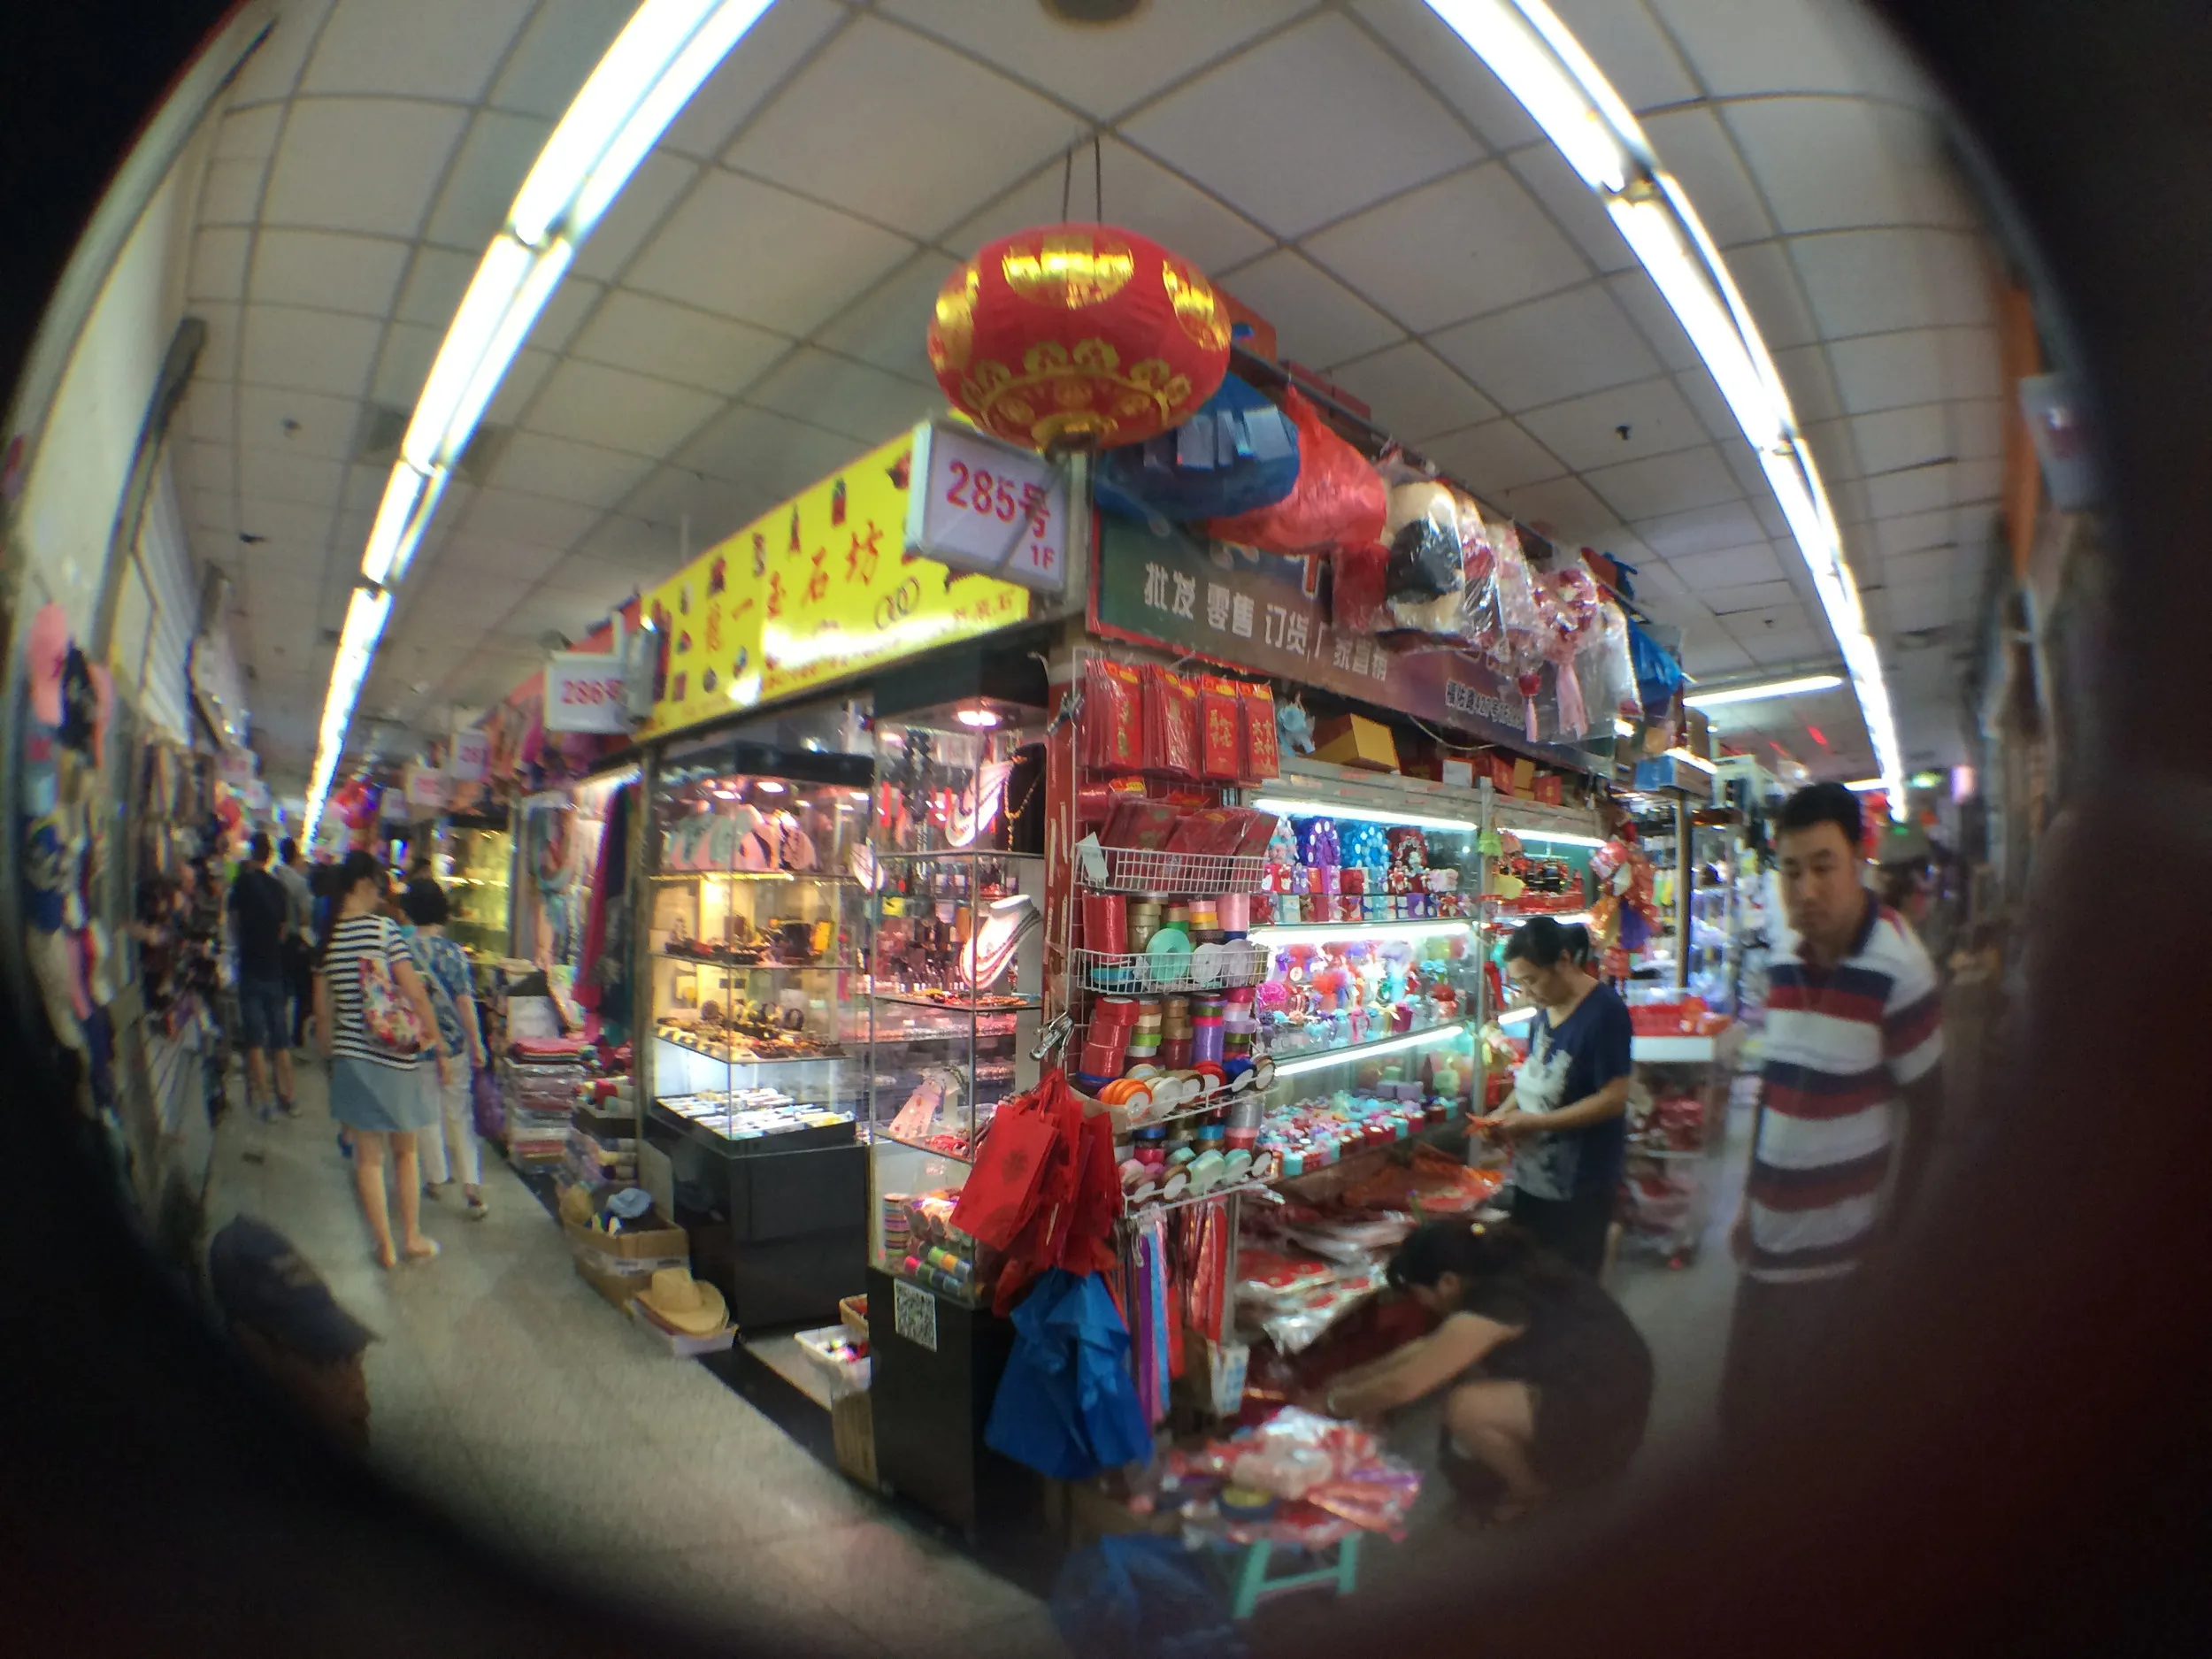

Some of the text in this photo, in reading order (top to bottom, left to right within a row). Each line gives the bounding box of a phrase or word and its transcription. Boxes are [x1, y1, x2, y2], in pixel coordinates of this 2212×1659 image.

[946, 459, 1051, 539] 285号
[1031, 543, 1056, 571] 1F
[1143, 561, 1195, 619] 批发
[1206, 581, 1255, 639] 零售
[1264, 603, 1310, 656] 订货
